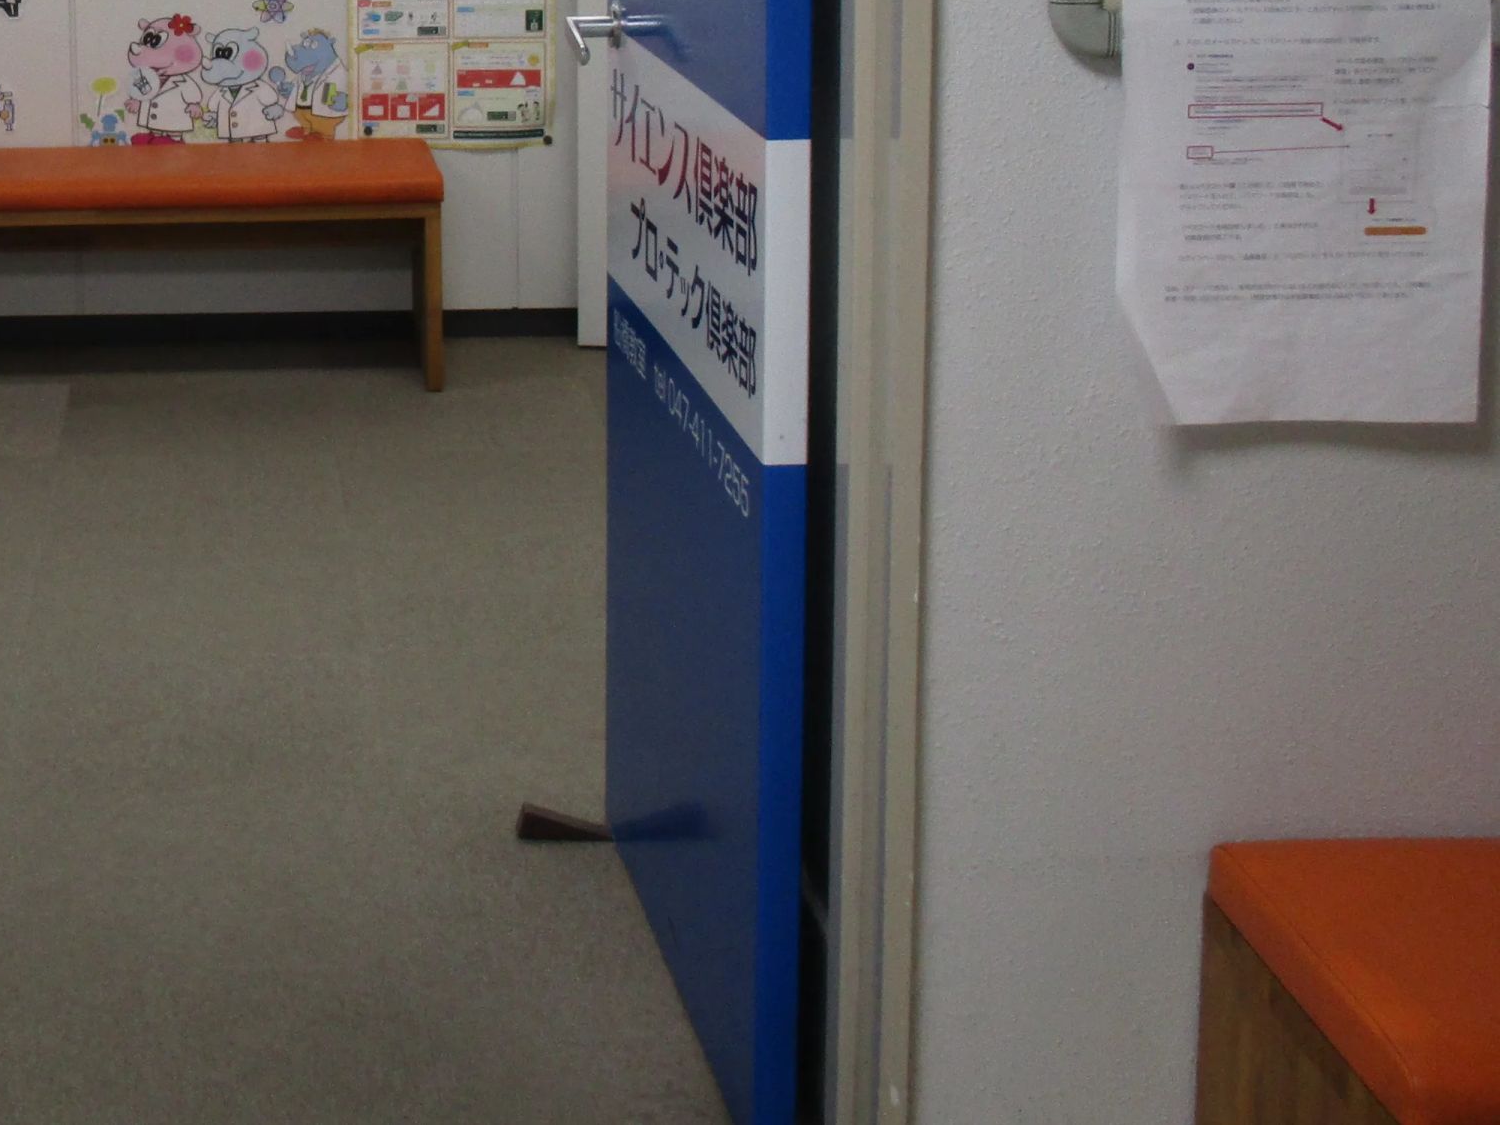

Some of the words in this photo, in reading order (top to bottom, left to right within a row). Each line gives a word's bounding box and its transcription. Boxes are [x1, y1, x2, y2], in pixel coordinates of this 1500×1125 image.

[610, 68, 759, 277] サイエンス倶楽部
